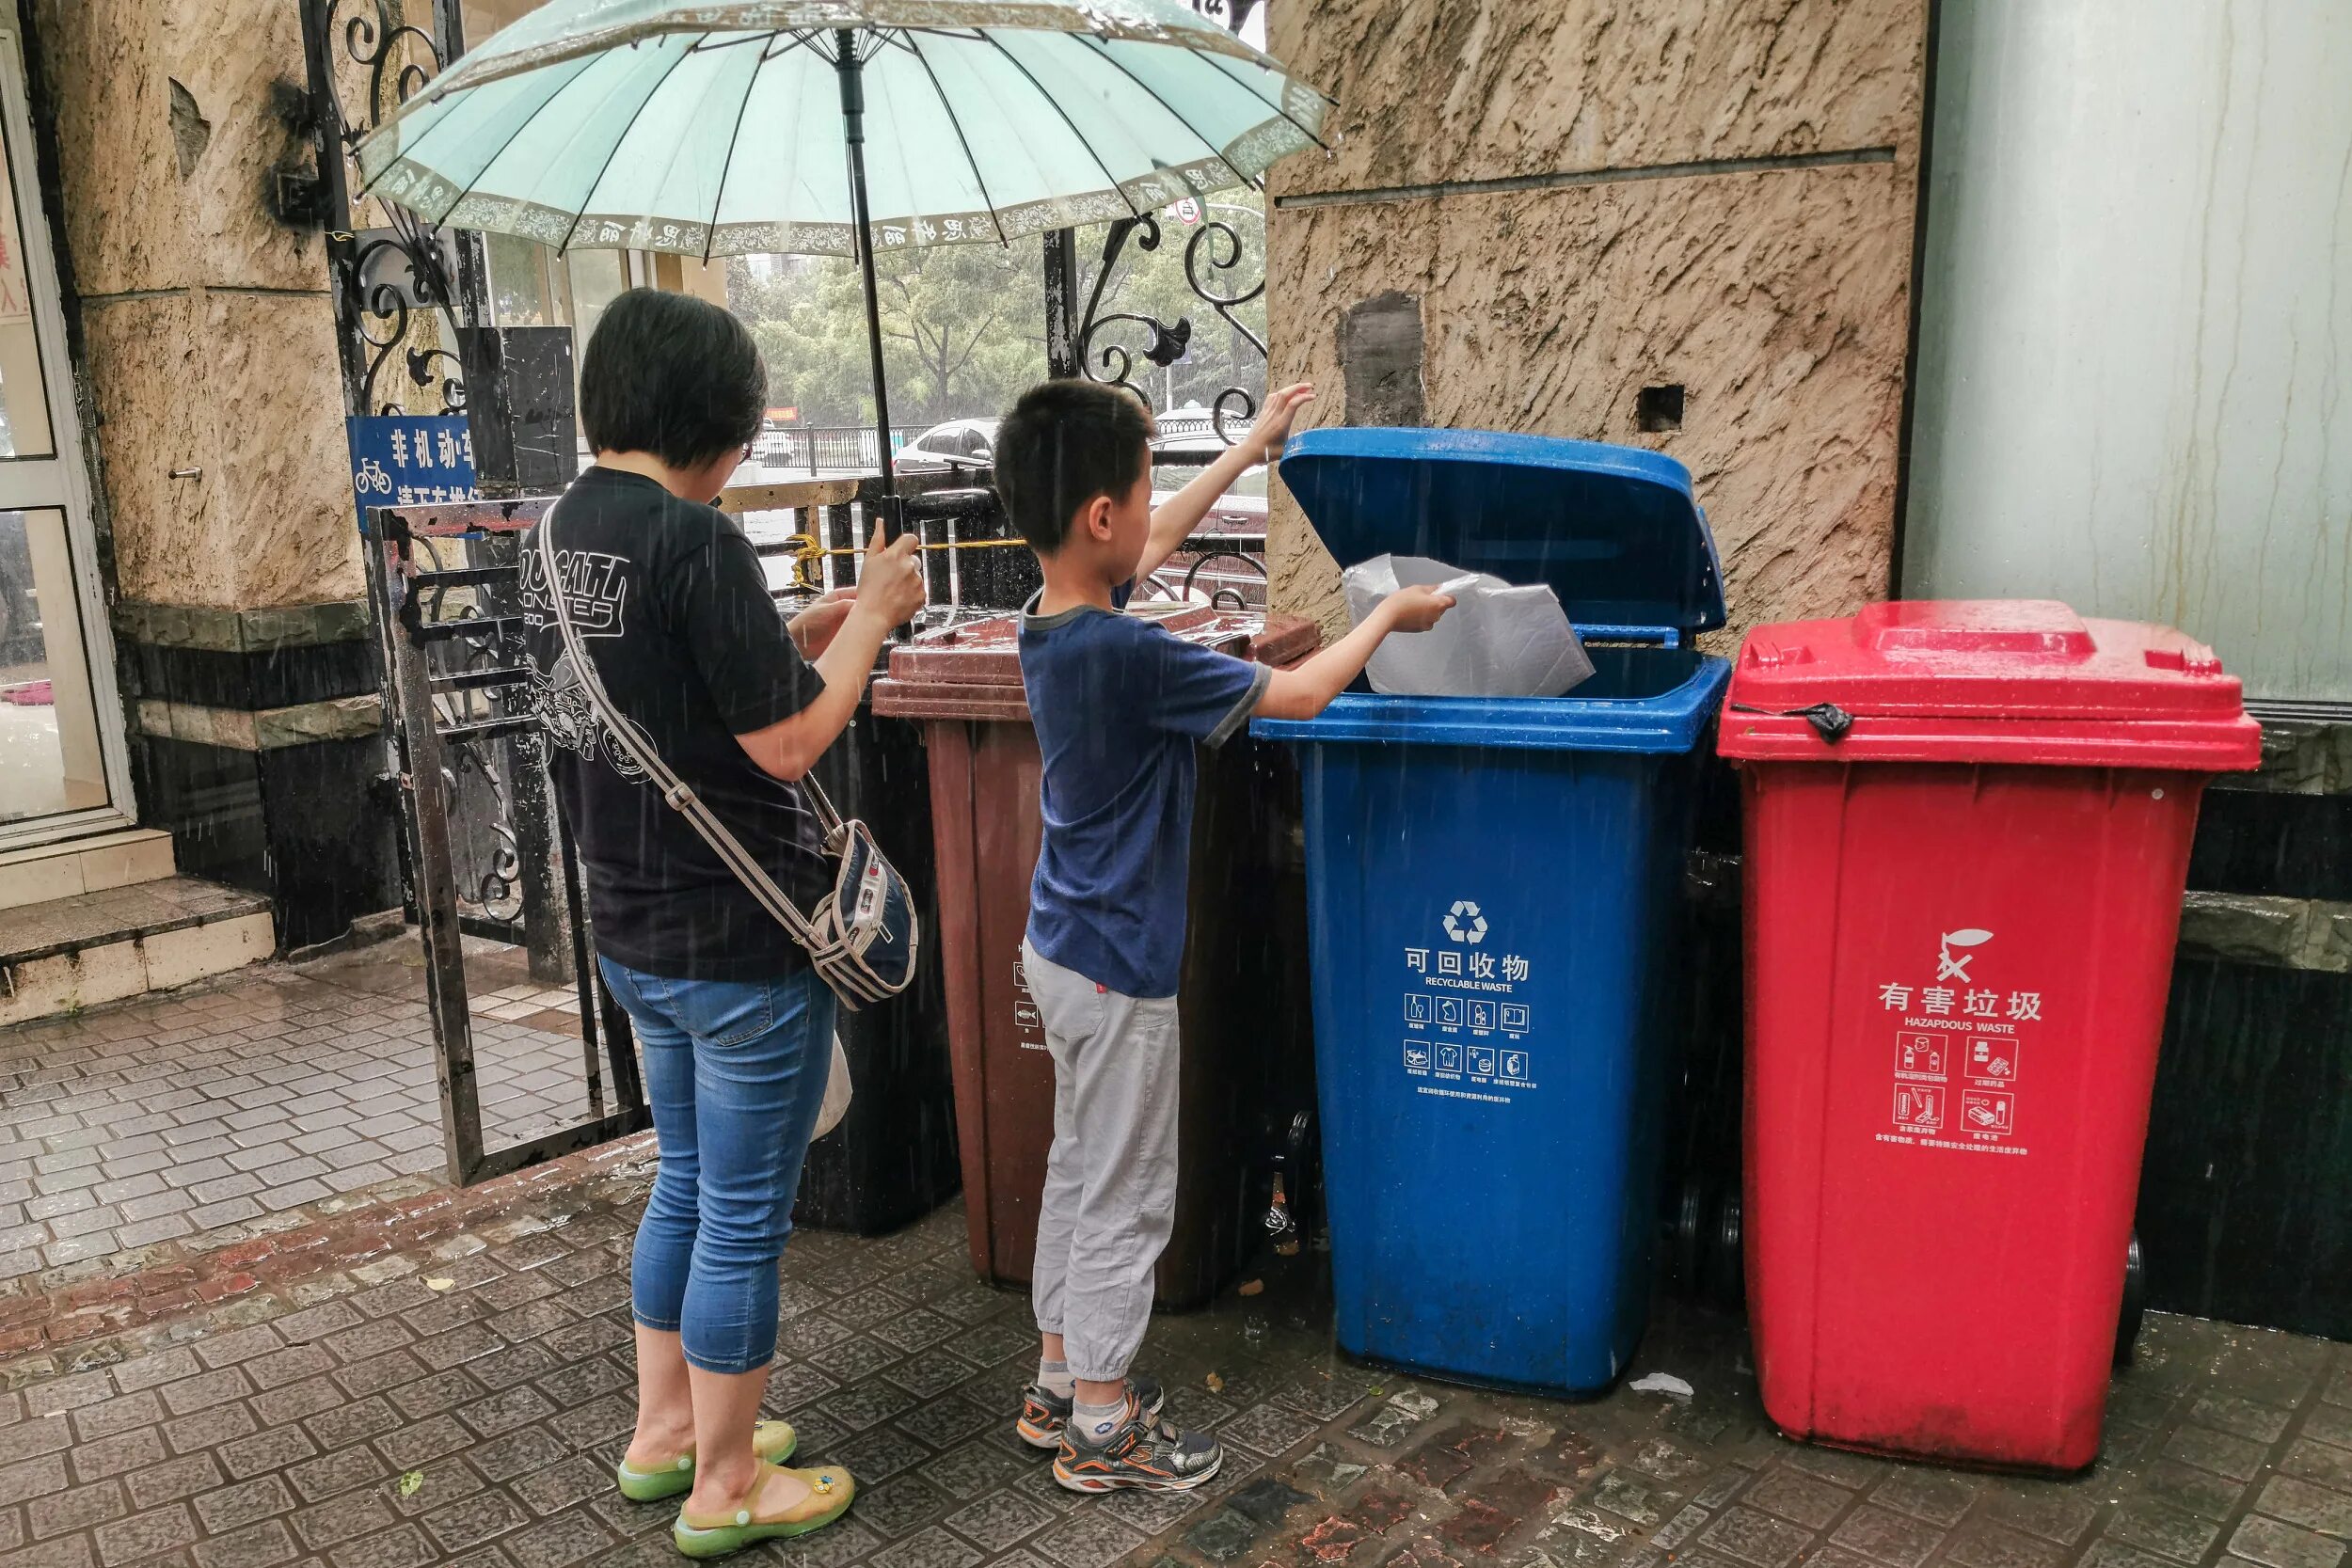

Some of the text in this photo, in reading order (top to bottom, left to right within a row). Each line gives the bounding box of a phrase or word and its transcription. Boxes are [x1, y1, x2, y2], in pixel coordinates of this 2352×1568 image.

[517, 593, 613, 621] ONSTER
[1405, 947, 1529, 982] 可回收物
[1425, 976, 1513, 993] RECYCLABLE WASTE
[1878, 982, 2042, 1021] 有害垃圾
[1977, 1022, 2016, 1035] WASTE
